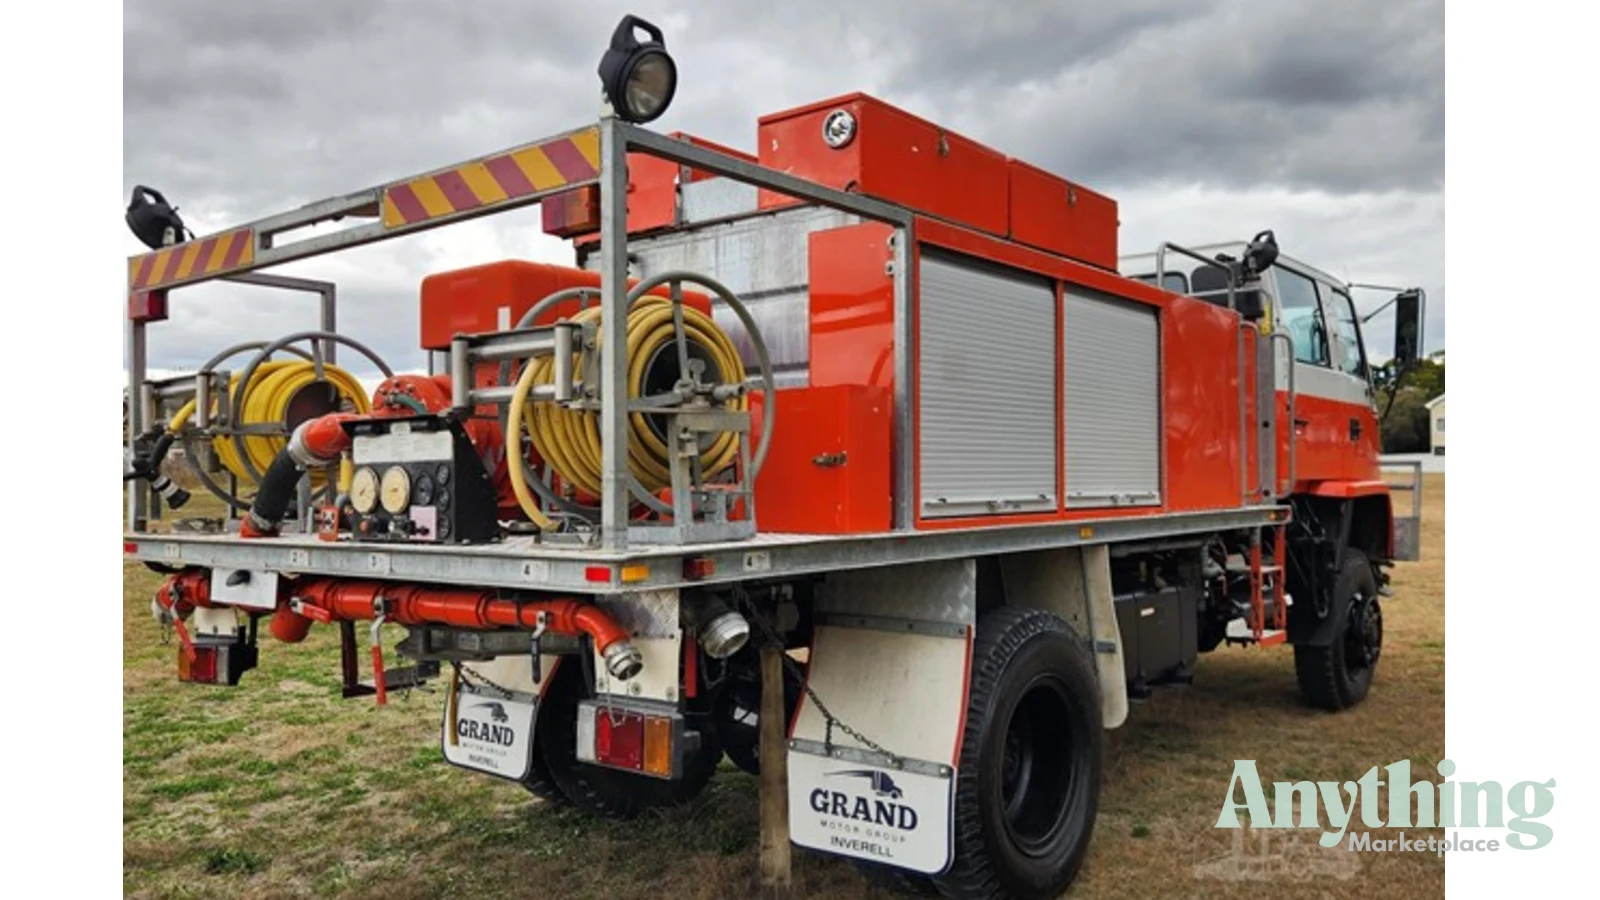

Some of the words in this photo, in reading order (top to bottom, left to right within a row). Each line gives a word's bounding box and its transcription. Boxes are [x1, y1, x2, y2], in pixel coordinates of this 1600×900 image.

[458, 718, 515, 747] GRAND
[810, 787, 918, 831] GRAND
[820, 820, 860, 833] MOTOR
[865, 828, 906, 843] GROUP
[831, 835, 893, 858] INVERELL
